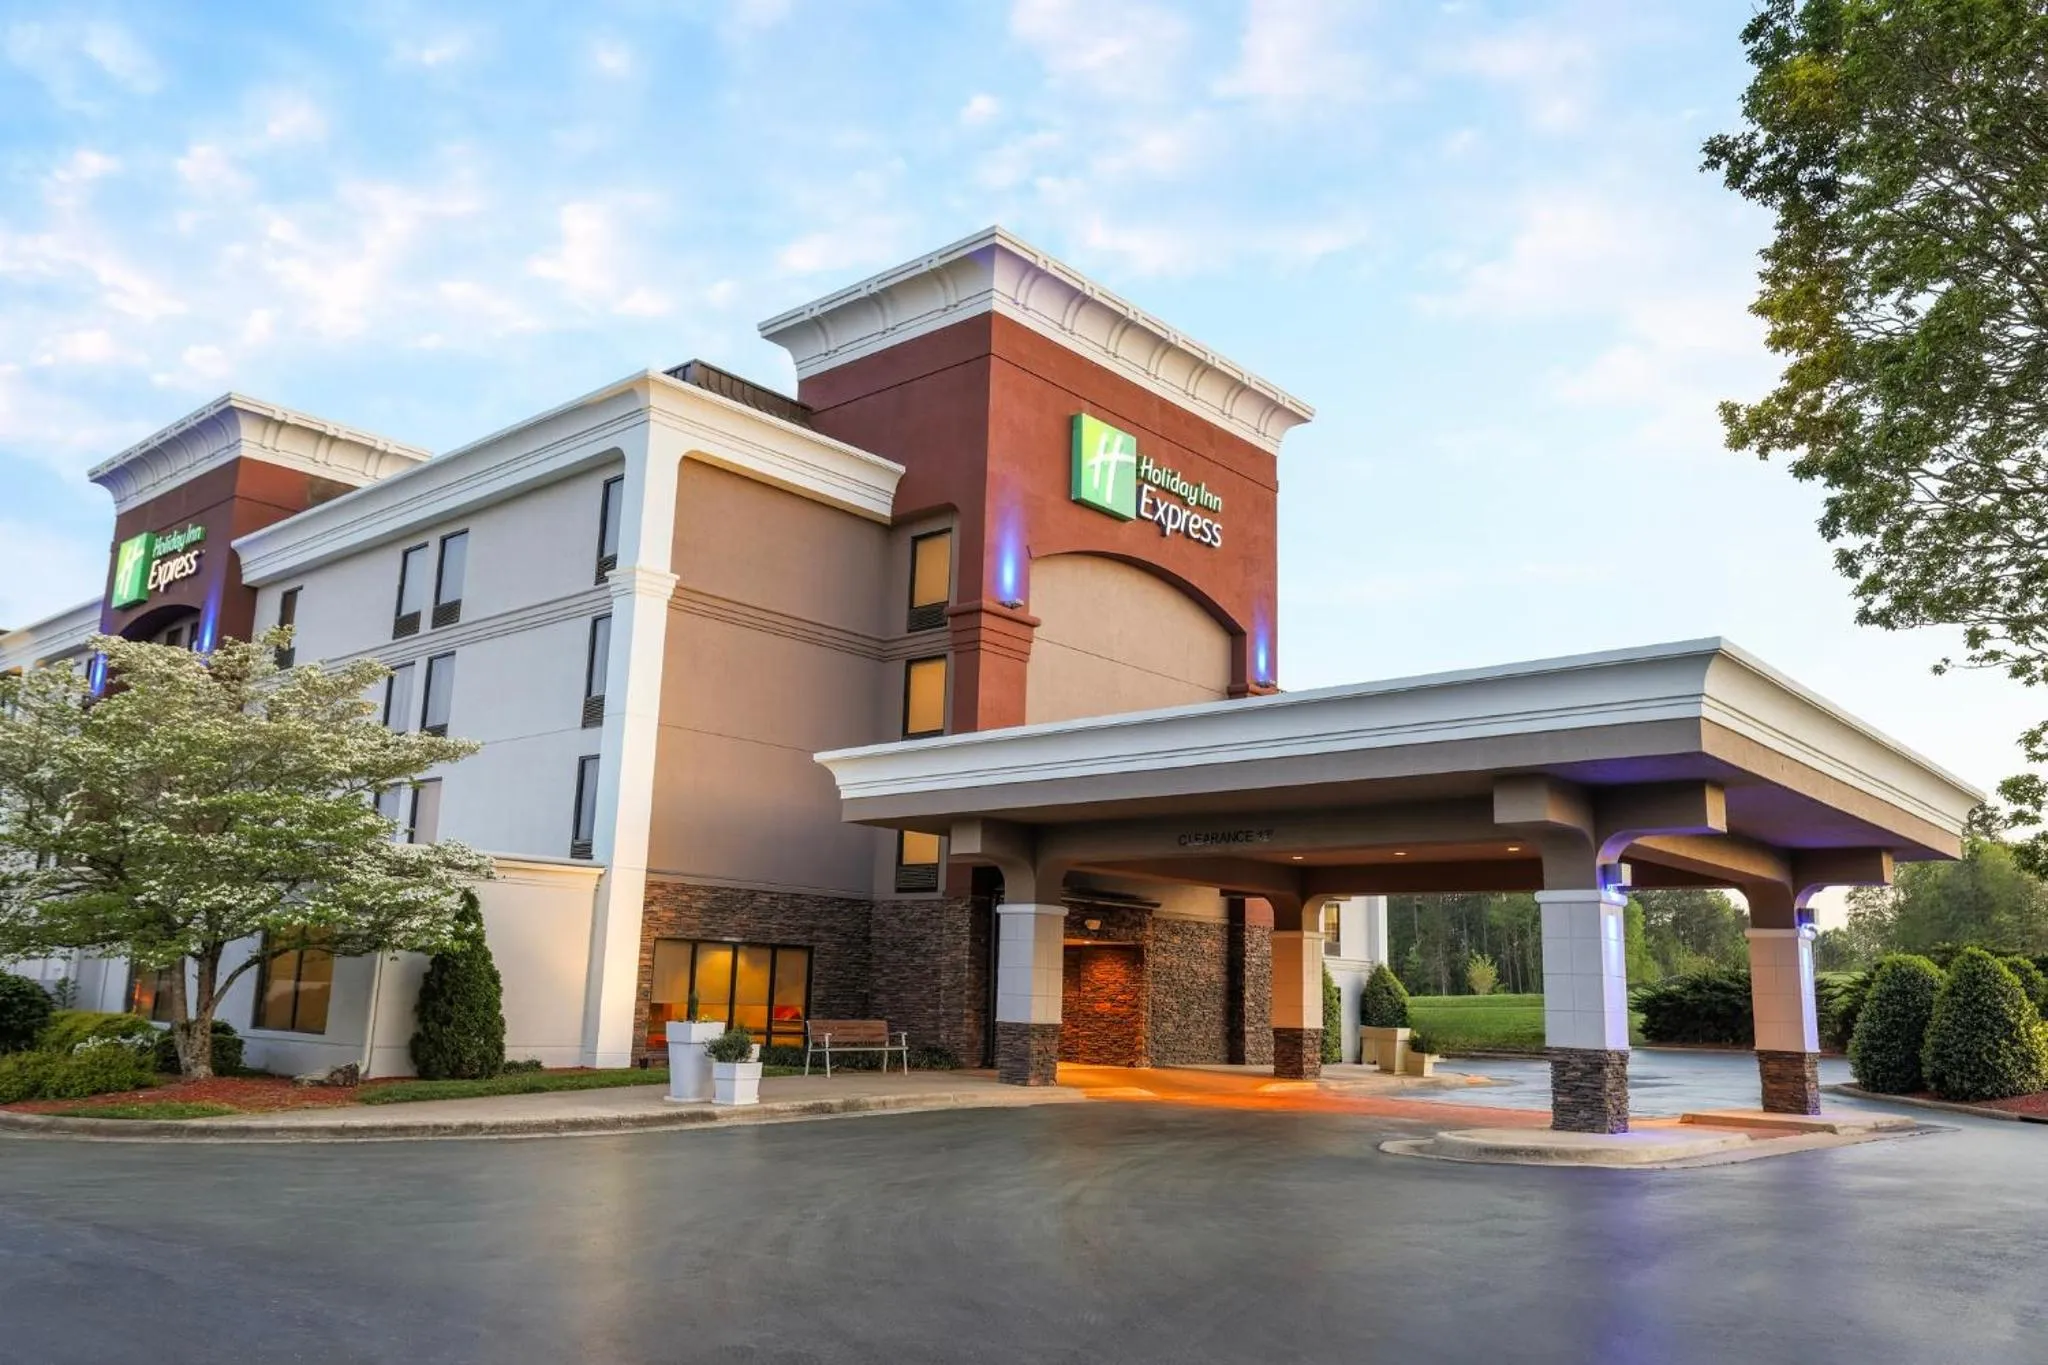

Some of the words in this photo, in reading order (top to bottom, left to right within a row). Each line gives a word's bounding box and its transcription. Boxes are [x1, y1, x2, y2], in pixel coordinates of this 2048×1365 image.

[1140, 455, 1198, 505] Holiday
[1199, 482, 1222, 512] Inn
[1139, 484, 1223, 547] Express
[152, 530, 185, 558] Holiday
[185, 523, 202, 544] Inn
[147, 550, 199, 592] Express
[1177, 829, 1254, 846] CLEARANCE
